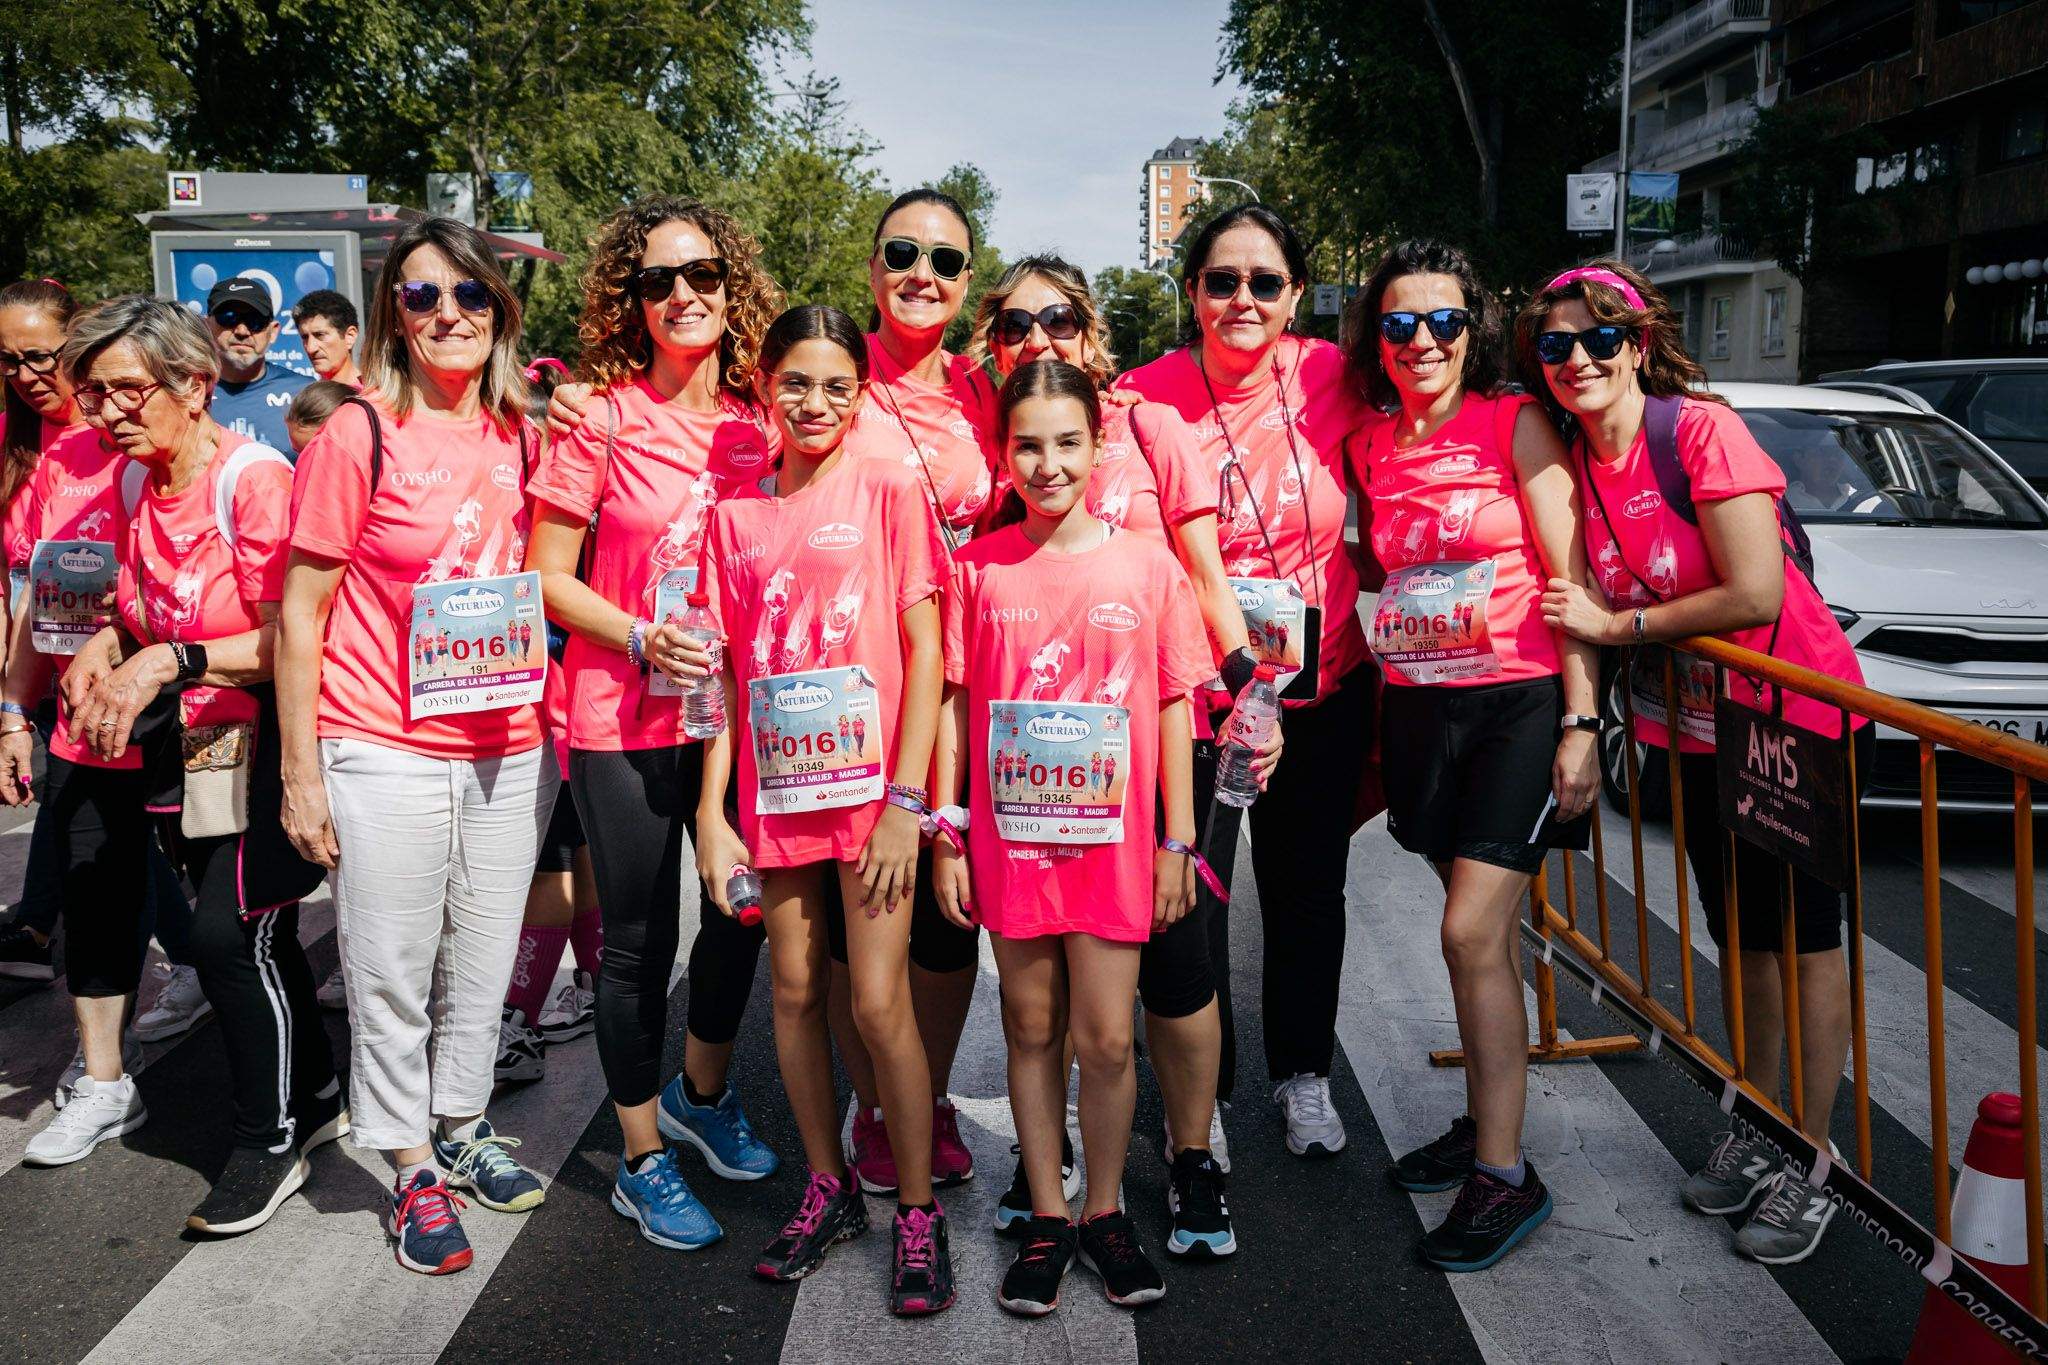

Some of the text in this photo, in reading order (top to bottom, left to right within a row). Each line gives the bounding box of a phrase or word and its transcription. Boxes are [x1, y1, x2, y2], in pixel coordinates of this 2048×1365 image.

[351, 177, 363, 189] 21
[233, 239, 272, 248] JCDecaux
[288, 350, 303, 361] de
[729, 453, 760, 463] ASTURIANA
[391, 468, 452, 487] OYSHO
[813, 534, 859, 545] ASTURIANA
[61, 556, 103, 568] ASTURIANA
[726, 544, 766, 569] OYSHO
[1406, 580, 1452, 591] ASTURIANA
[447, 599, 501, 612] ASTURIANA
[982, 607, 1039, 623] OYSHO
[1092, 612, 1136, 626] ASTURIANA
[1404, 614, 1447, 636] 016
[451, 636, 506, 661] 016
[1412, 640, 1439, 650] 19350
[1384, 647, 1478, 661] CARRERA DE LA MUJER MADRID
[470, 665, 489, 675] 191
[1444, 662, 1485, 673] Santander
[423, 671, 531, 691] CARRERA DE LA MUJER MADRID
[423, 688, 531, 708] OYSHO Santander
[777, 693, 830, 707] ASTURIANA
[1030, 721, 1087, 736] ASTURIANA
[781, 731, 836, 758] 016
[1747, 721, 1798, 789] AMS
[792, 761, 824, 773] 19349
[786, 777, 795, 785] DE
[796, 776, 805, 784] LA
[807, 773, 833, 783] MUJER
[839, 768, 867, 779] MADRID
[1029, 764, 1086, 788] 016
[828, 785, 871, 799] Santander
[1740, 769, 1810, 810] SOLUCIONES EN EVENTOS
[1038, 793, 1072, 804] 19345
[1002, 804, 1109, 816] CARRERA DE LA MUJER MADRID
[1001, 820, 1108, 835] OYSHO Santander
[1755, 807, 1811, 847] alquiler-ms.com
[1008, 848, 1039, 860] CARRERA
[1057, 847, 1083, 859] MUJER
[1741, 1155, 1771, 1181] N
[1801, 1197, 1829, 1223] N
